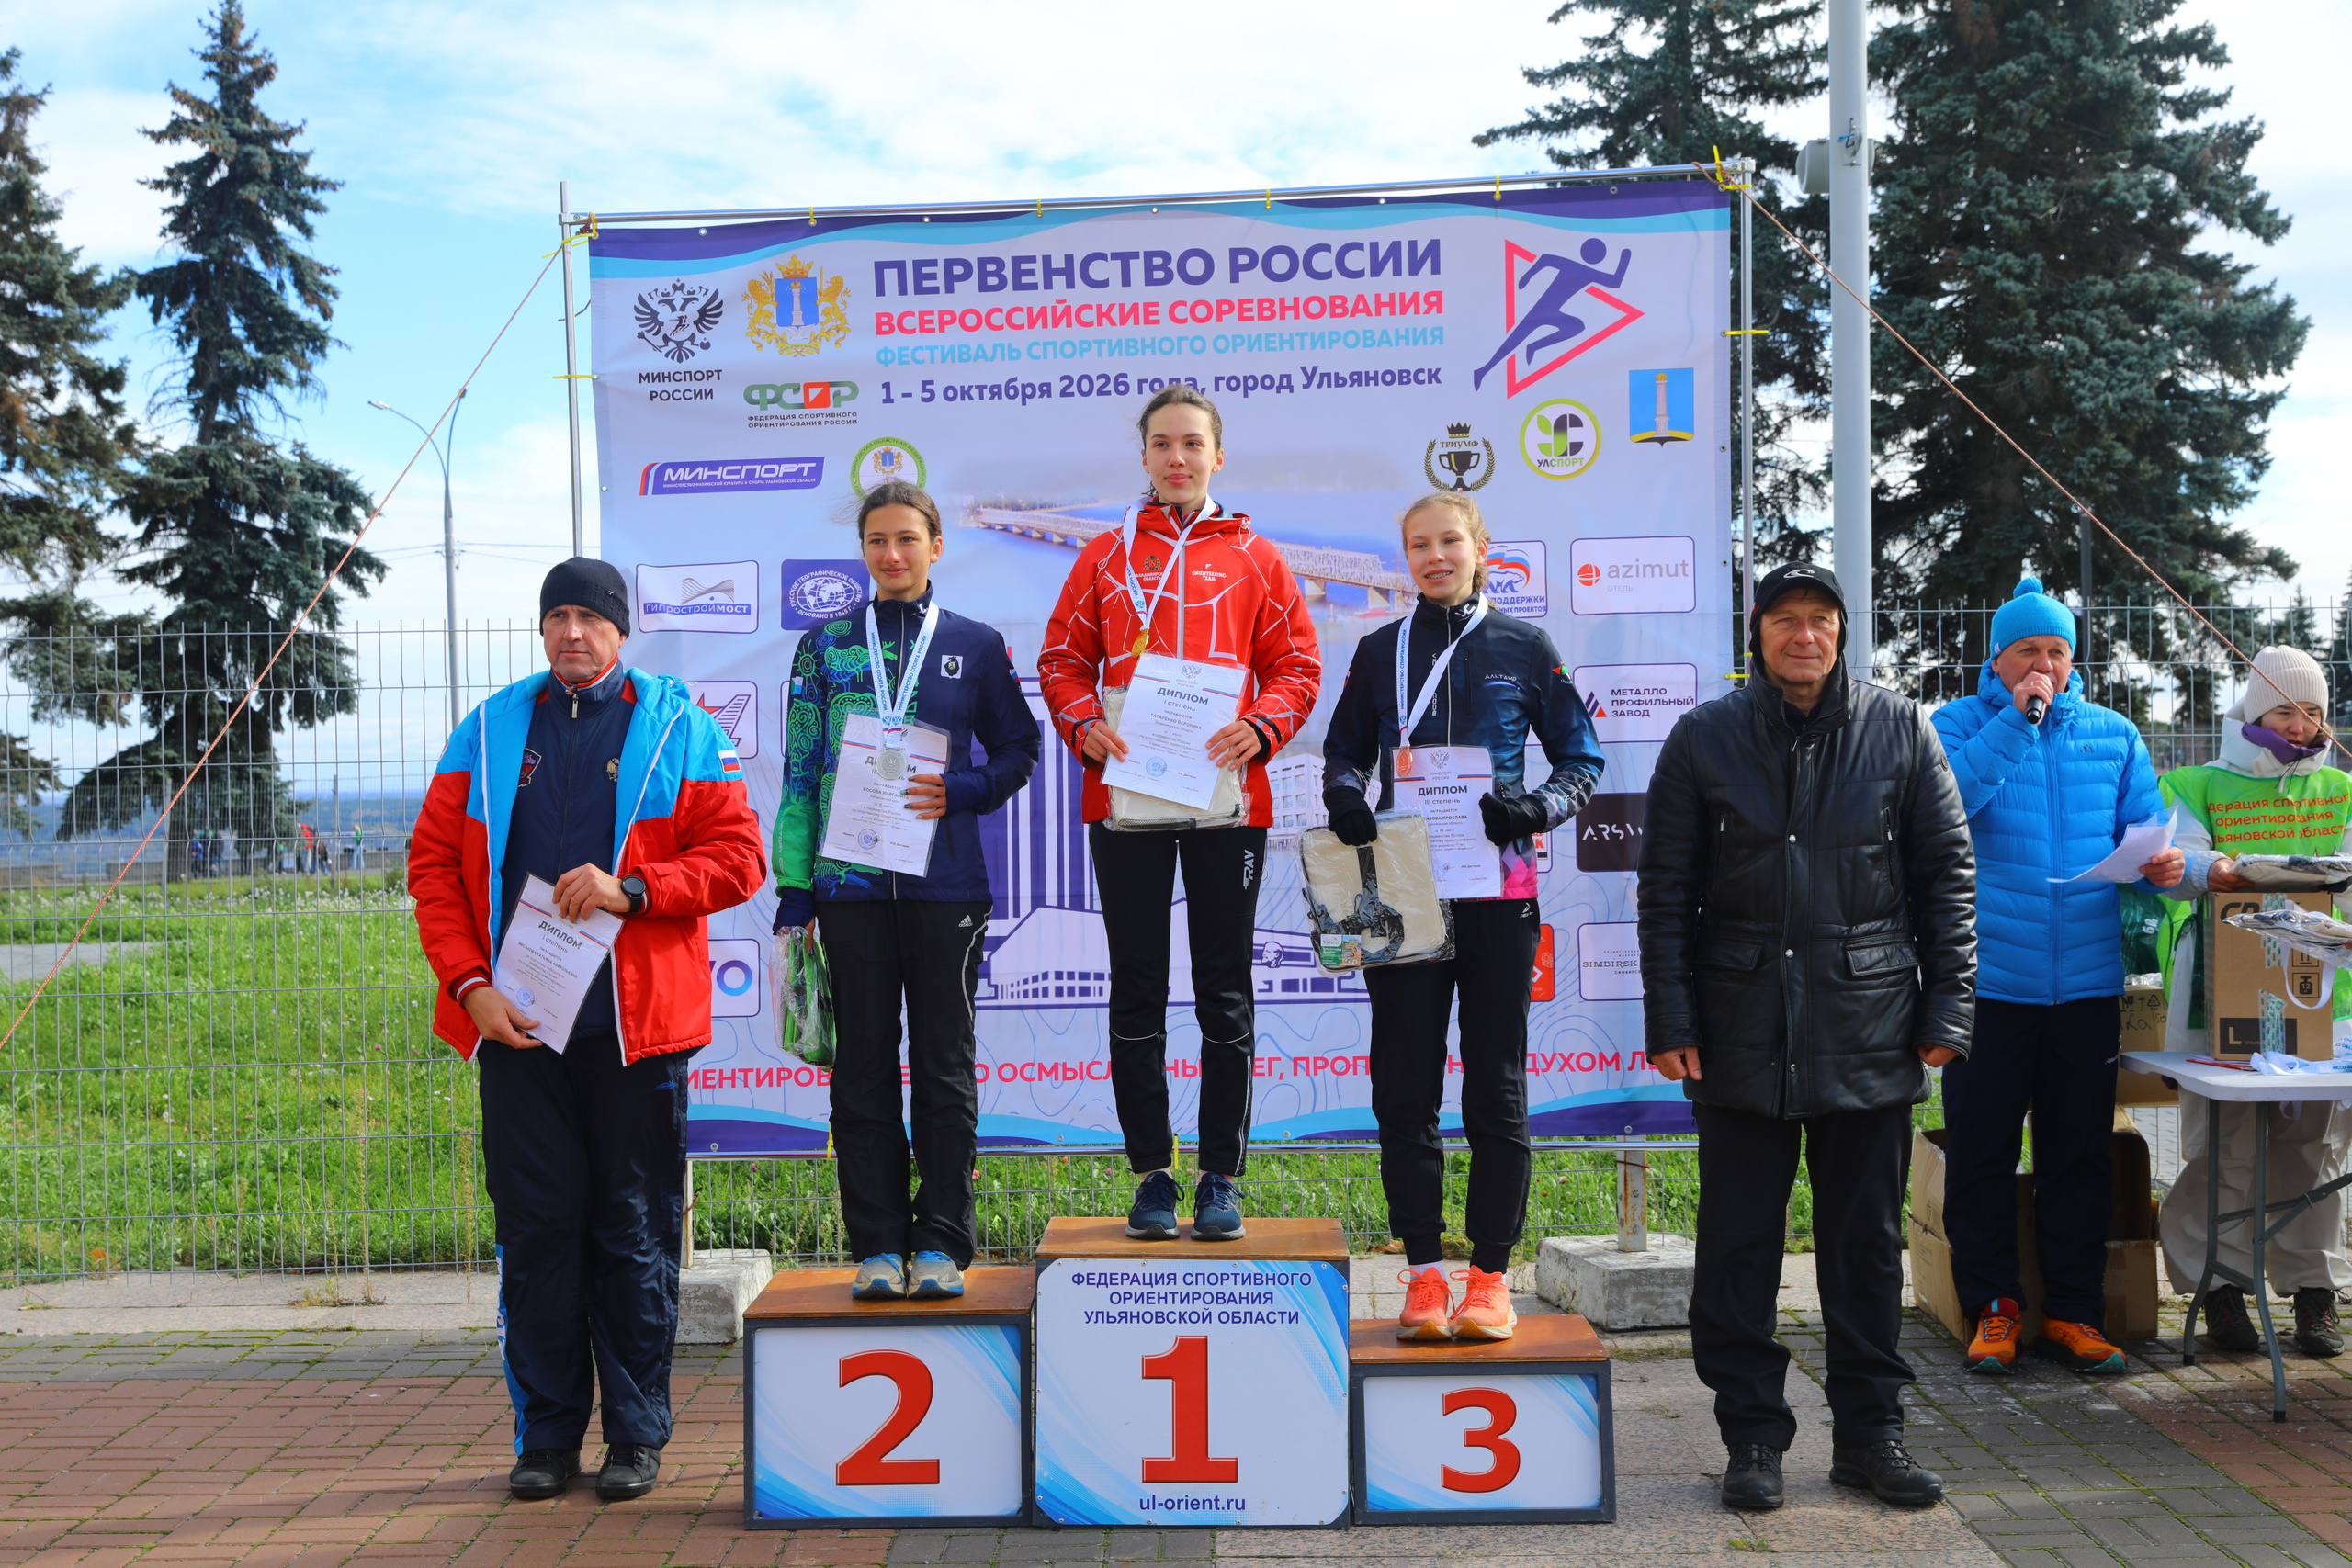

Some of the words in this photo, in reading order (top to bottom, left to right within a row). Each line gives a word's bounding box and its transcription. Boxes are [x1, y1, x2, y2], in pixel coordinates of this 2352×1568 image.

[874, 247, 1216, 297] ПЕРВЕНСТВО
[1228, 238, 1442, 284] РОССИИ
[875, 299, 1161, 336] ВСЕРОССИЙСКИЕ
[1168, 290, 1443, 325] СОРЕВНОВАНИЯ
[876, 342, 1022, 367] ФЕСТИВАЛЬ
[1026, 334, 1207, 360] СПОРТИВНОГО
[1213, 326, 1444, 354] ОРИЕНТИРОВАНИЯ
[638, 369, 723, 384] МИНСПОРТ
[881, 381, 895, 404] 1
[920, 379, 936, 404] 5
[943, 376, 1053, 406] октября
[1059, 372, 1131, 399] 2026
[1213, 371, 1295, 399] город
[1299, 365, 1442, 390] Ульяновск
[650, 388, 714, 402] РОССИИ
[747, 413, 797, 423] ФЕДЕРАЦИЯ
[798, 412, 858, 421] СПОРТИВНОГО
[748, 420, 822, 429] ОРИЕНТИРОВАНИЯ
[1439, 439, 1479, 449] ТРИУМФ
[1536, 457, 1585, 468] УЛСПОРТ
[663, 462, 817, 482] МИНСПОРТ
[1192, 570, 1227, 579] ORIENTEERING
[1607, 558, 1689, 579] azimut
[797, 570, 849, 585] ГЕОГРАФИЧЕСКОЕ
[790, 578, 805, 607] РУССКОЕ
[797, 608, 829, 620] ОСНОВАНО
[834, 607, 849, 619] 1845
[898, 671, 913, 711] МИНИСТЕРСТВО
[910, 654, 920, 673] СПОРТА
[918, 635, 927, 655] РОССИИ
[1157, 686, 1209, 706] ДИПЛОМ
[1611, 687, 1668, 696] МЕТАЛЛО
[1167, 701, 1196, 712] степень
[1611, 695, 1694, 707] ПРОФИЛЬНЫЙ
[1611, 709, 1651, 718] ЗАВОД
[1418, 785, 1468, 797] ДИПЛОМ
[2208, 797, 2269, 814] дерация
[538, 919, 582, 951] ДИПЛОМ
[546, 937, 569, 954] степень
[2229, 1026, 2242, 1045] L
[1525, 1051, 1621, 1077] ДУХОМ
[1071, 1272, 1178, 1288] ФЕДЕРАЦИЯ
[1182, 1272, 1312, 1287] СПОРТИВНОГО
[1109, 1292, 1274, 1305] ОРИЕНТИРОВАНИЯ
[1084, 1307, 1213, 1325] УЛЬЯНОВСКОЙ
[1217, 1310, 1299, 1325] ОБЛАСТИ
[834, 1348, 941, 1486] 2
[1141, 1335, 1238, 1483] 1
[1440, 1386, 1521, 1494] 3
[1139, 1494, 1246, 1511] ul-orient.ru
